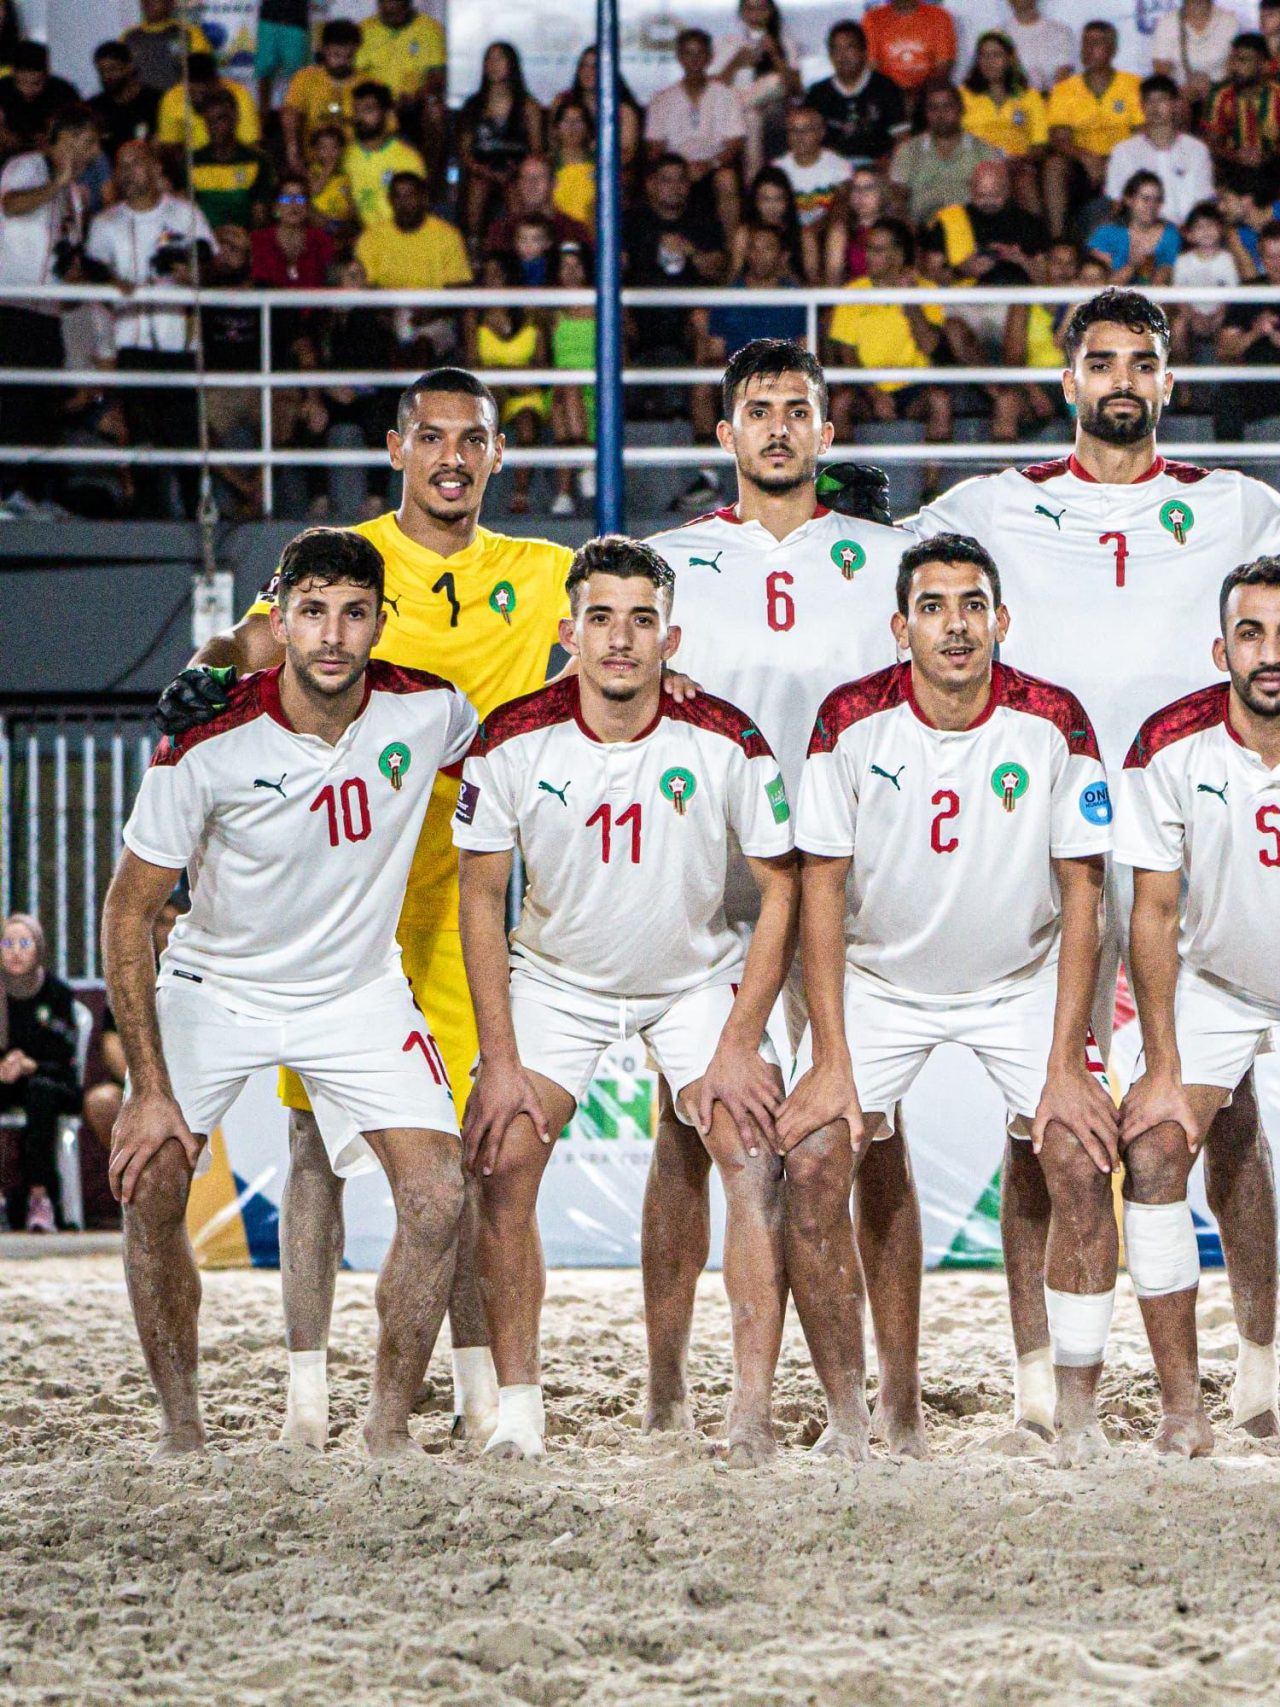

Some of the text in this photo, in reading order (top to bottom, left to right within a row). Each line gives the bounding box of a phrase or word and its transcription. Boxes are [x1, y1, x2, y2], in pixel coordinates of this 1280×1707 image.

[1099, 531, 1129, 588] 7
[431, 572, 460, 628] 1
[765, 570, 796, 632] 6
[309, 776, 373, 848] 10
[585, 802, 642, 865] 11
[930, 789, 961, 855] 2
